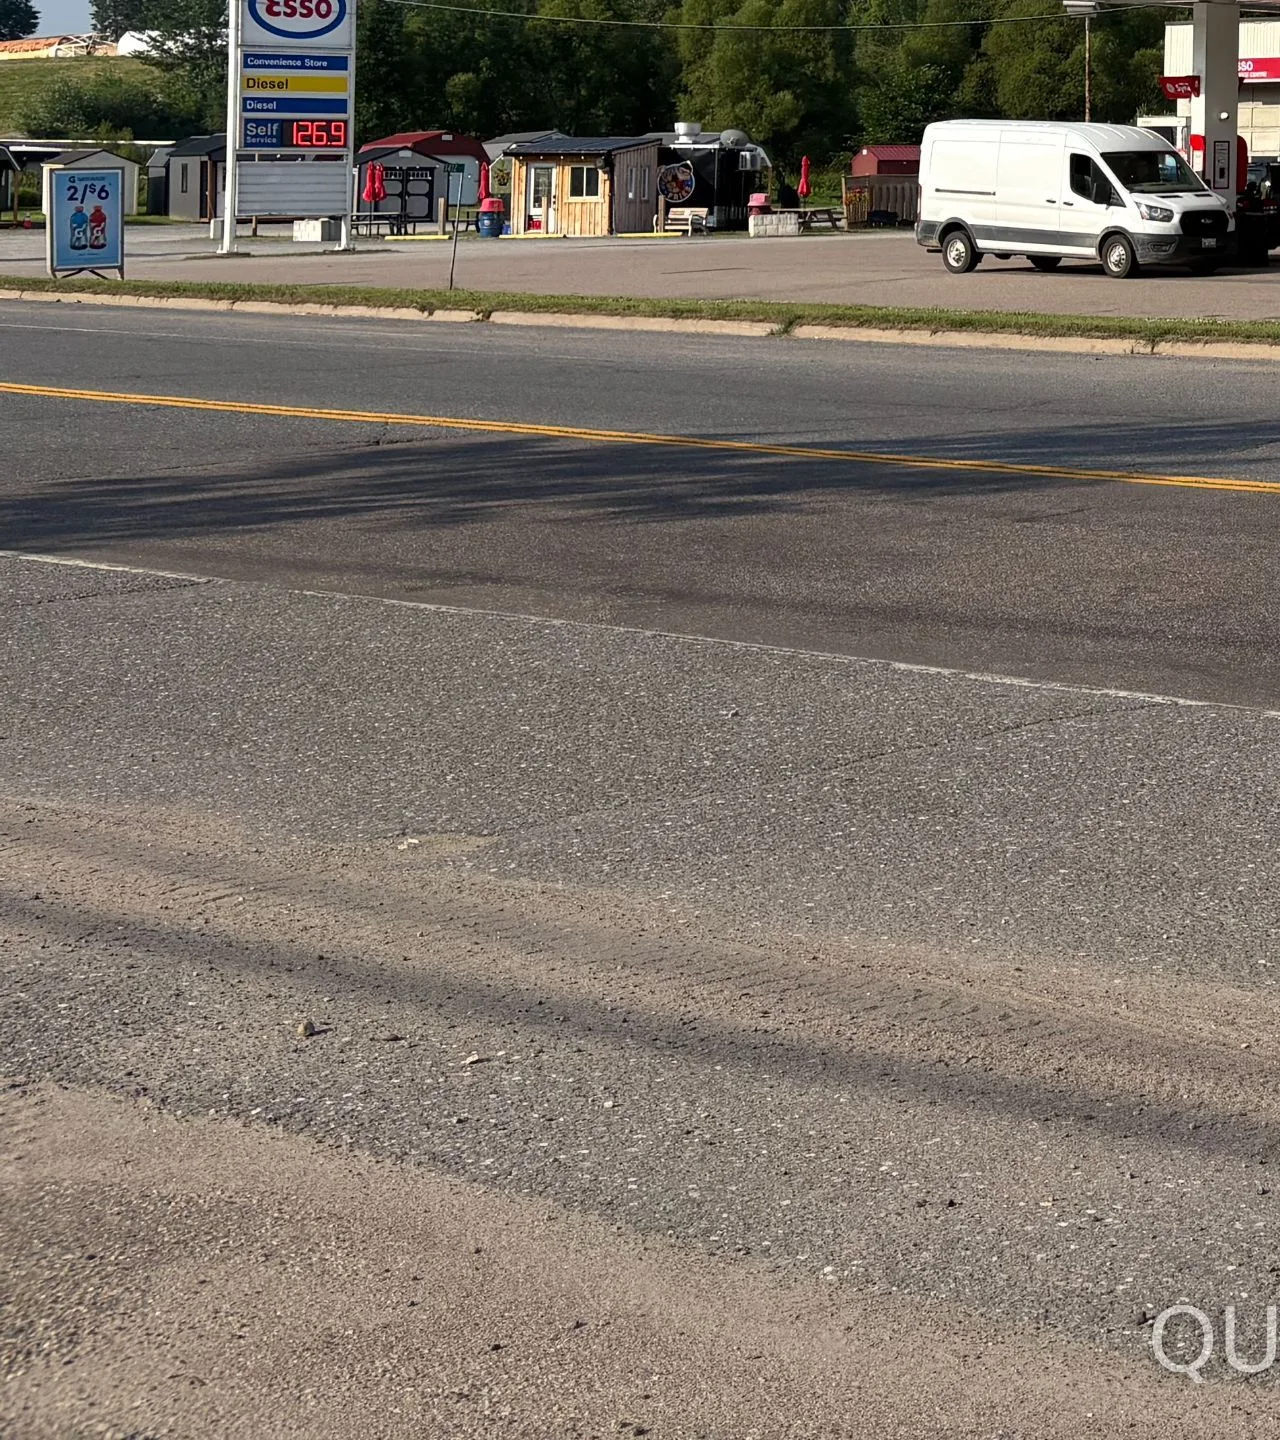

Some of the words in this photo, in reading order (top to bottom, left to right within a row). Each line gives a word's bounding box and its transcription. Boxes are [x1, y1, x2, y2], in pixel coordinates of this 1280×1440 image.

[247, 57, 302, 67] Convenience
[304, 59, 328, 68] Store
[246, 78, 288, 90] Diesel
[246, 101, 277, 110] Diesel
[246, 123, 279, 136] Self
[293, 122, 345, 145] 126.9
